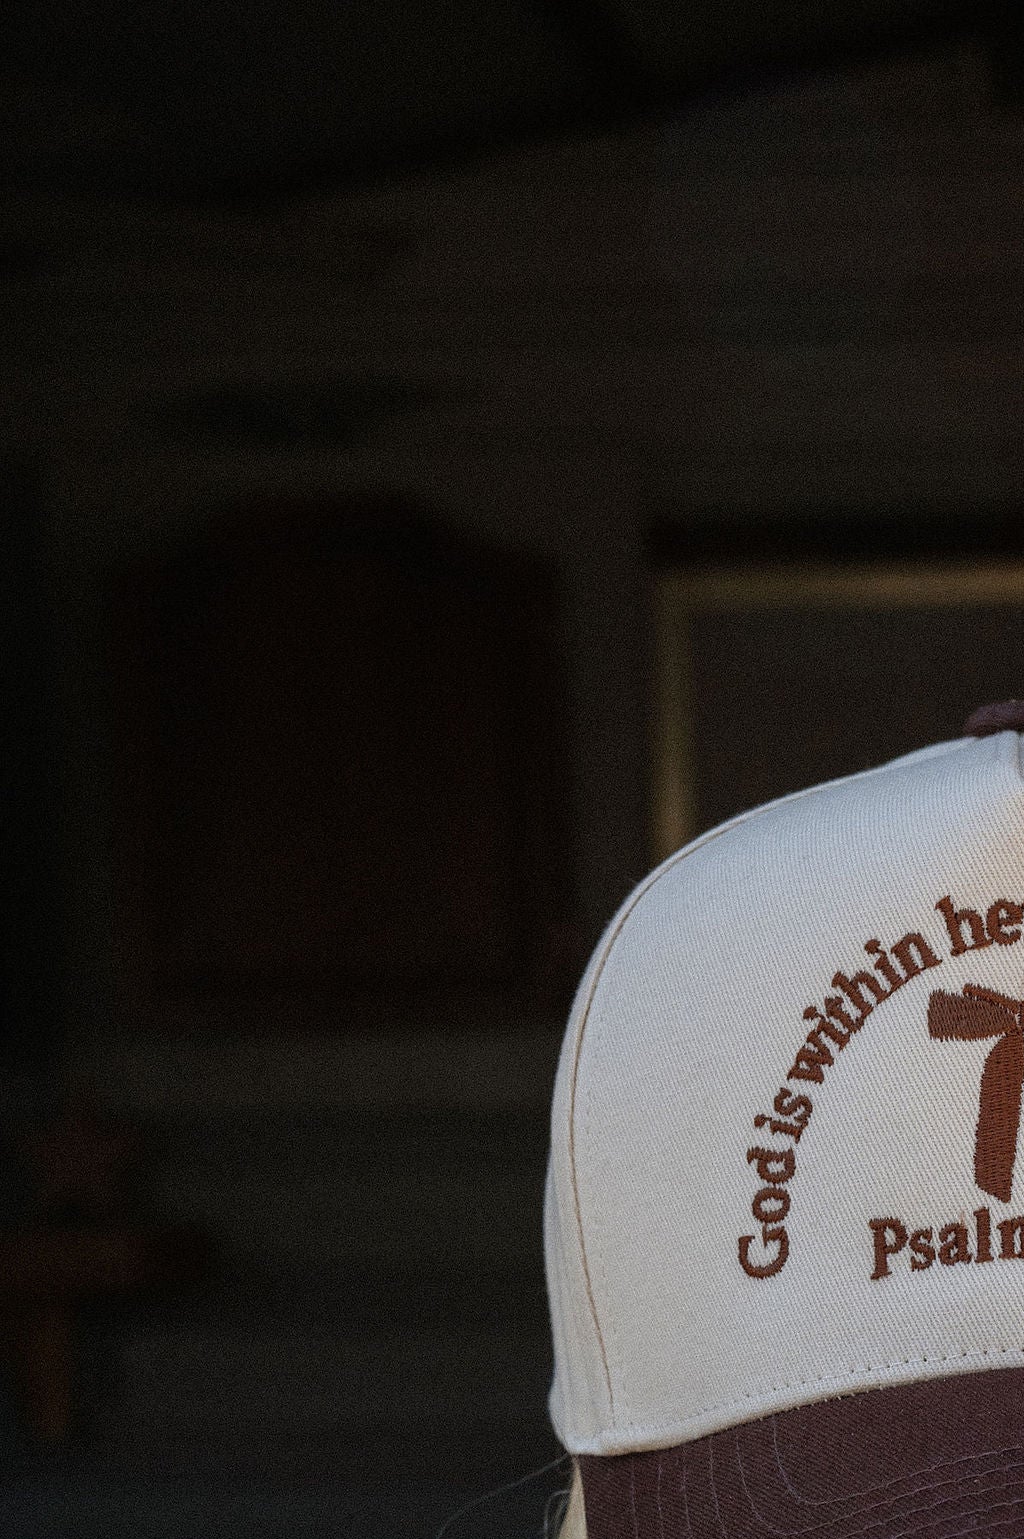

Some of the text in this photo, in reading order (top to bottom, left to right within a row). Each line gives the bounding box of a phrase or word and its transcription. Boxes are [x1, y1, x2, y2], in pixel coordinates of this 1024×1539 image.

[786, 933, 942, 1085] within
[754, 1087, 814, 1144] is
[738, 1147, 796, 1280] God
